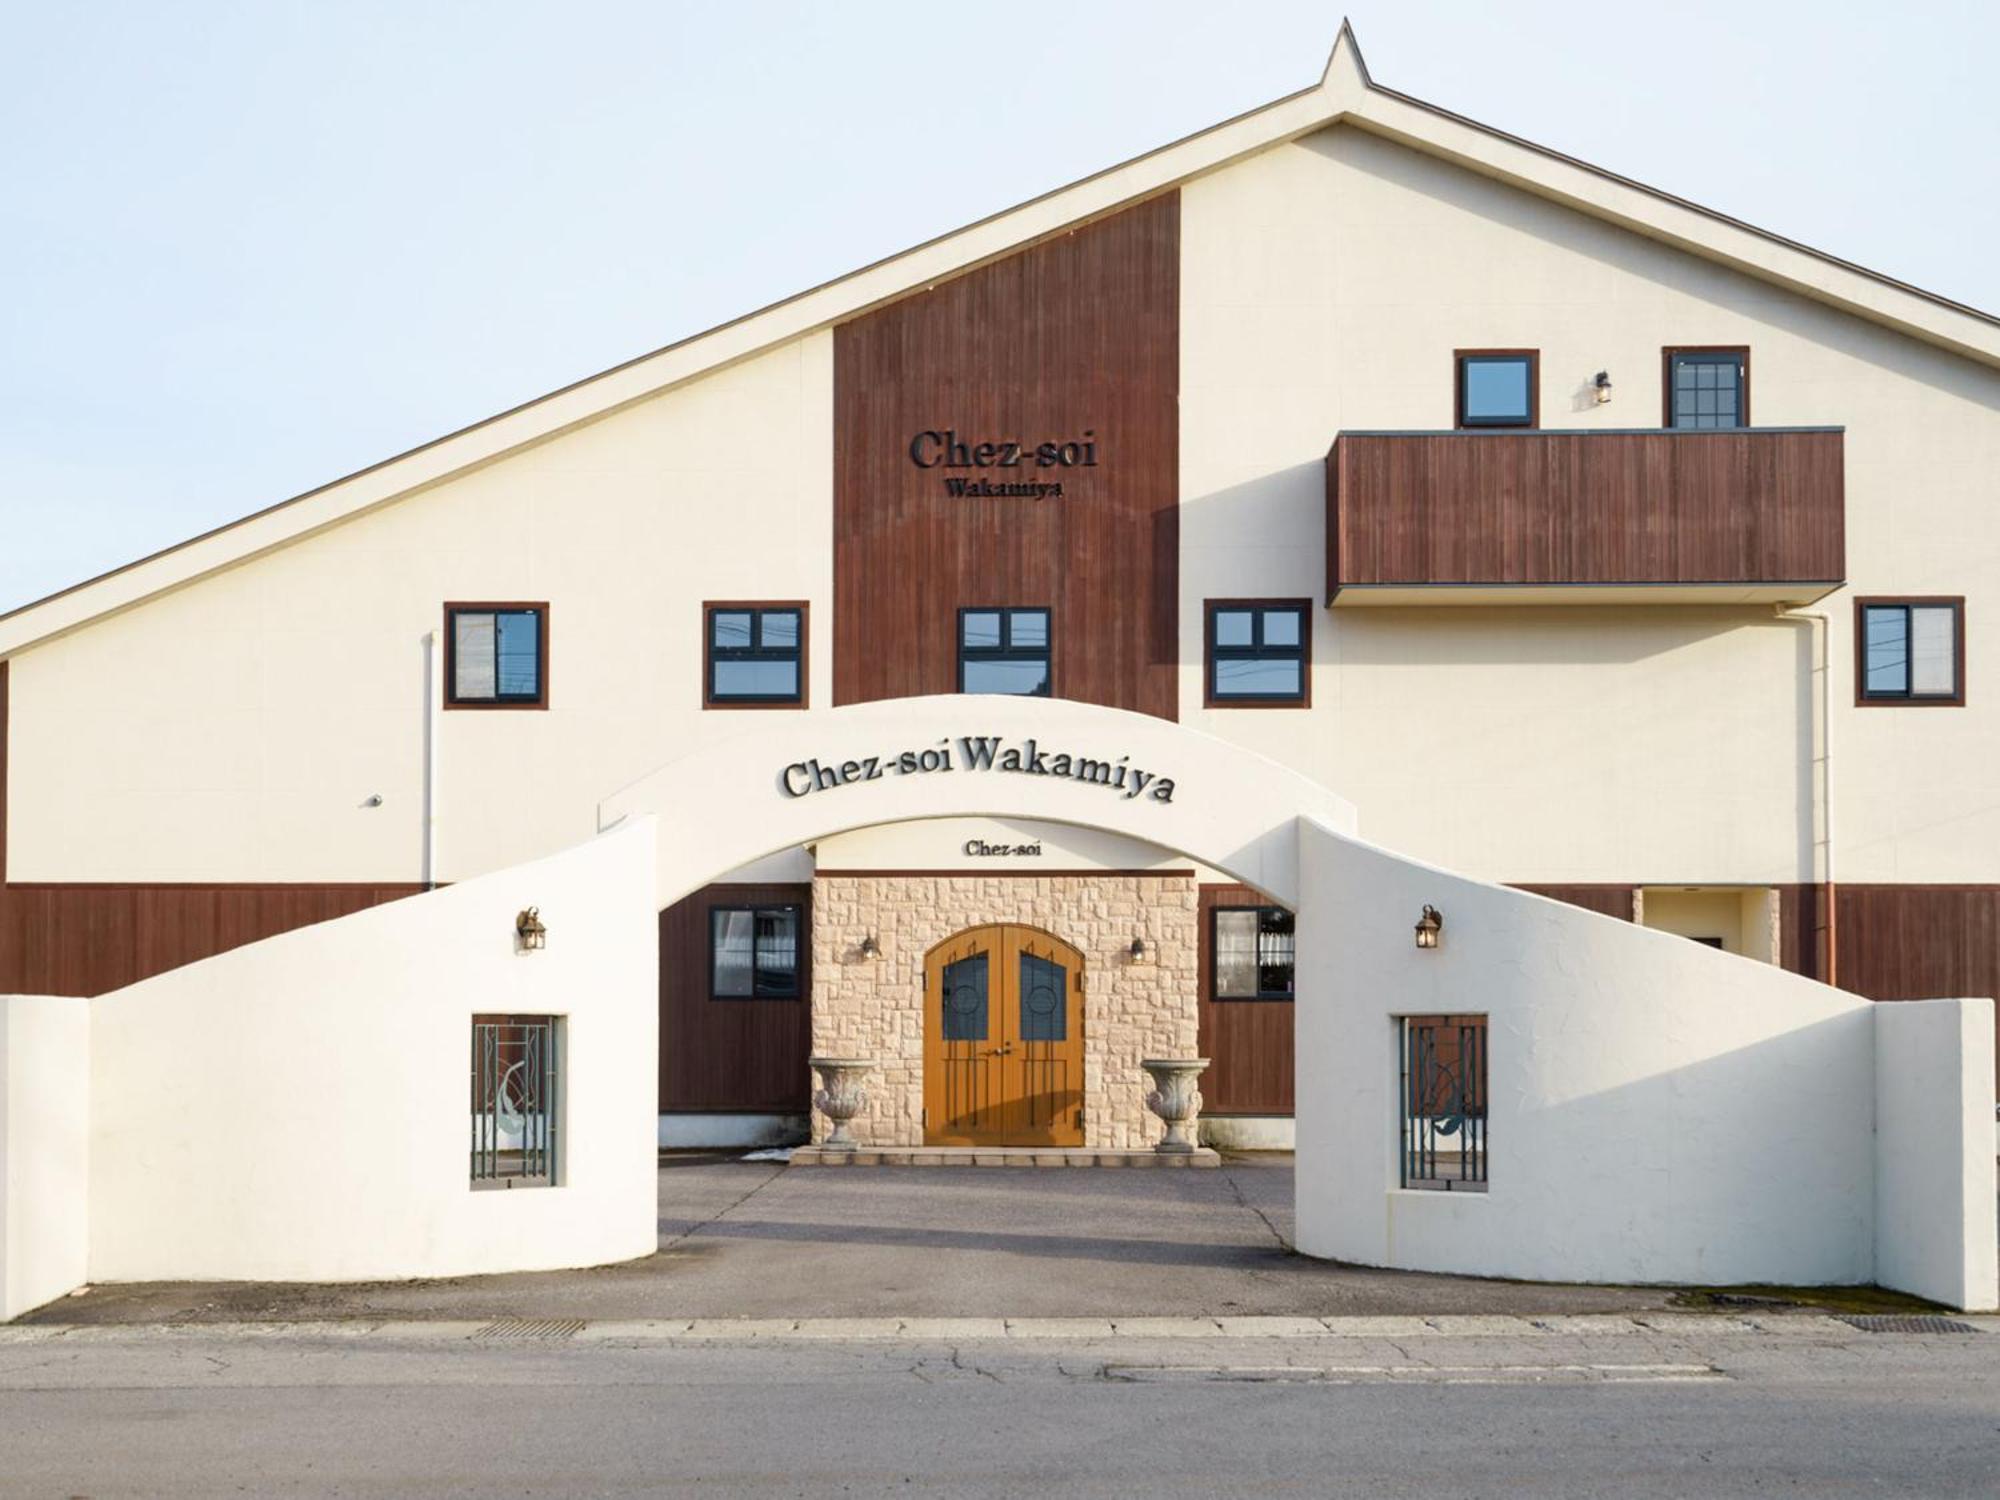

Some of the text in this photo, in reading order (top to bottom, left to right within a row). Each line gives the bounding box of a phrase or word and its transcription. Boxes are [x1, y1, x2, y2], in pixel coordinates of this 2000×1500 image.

[909, 430, 1098, 469] Chez-soi
[944, 476, 1063, 501] Wakamiya
[780, 736, 1177, 804] Chez-soi Wakamiya
[964, 840, 1042, 857] Chez-soi
